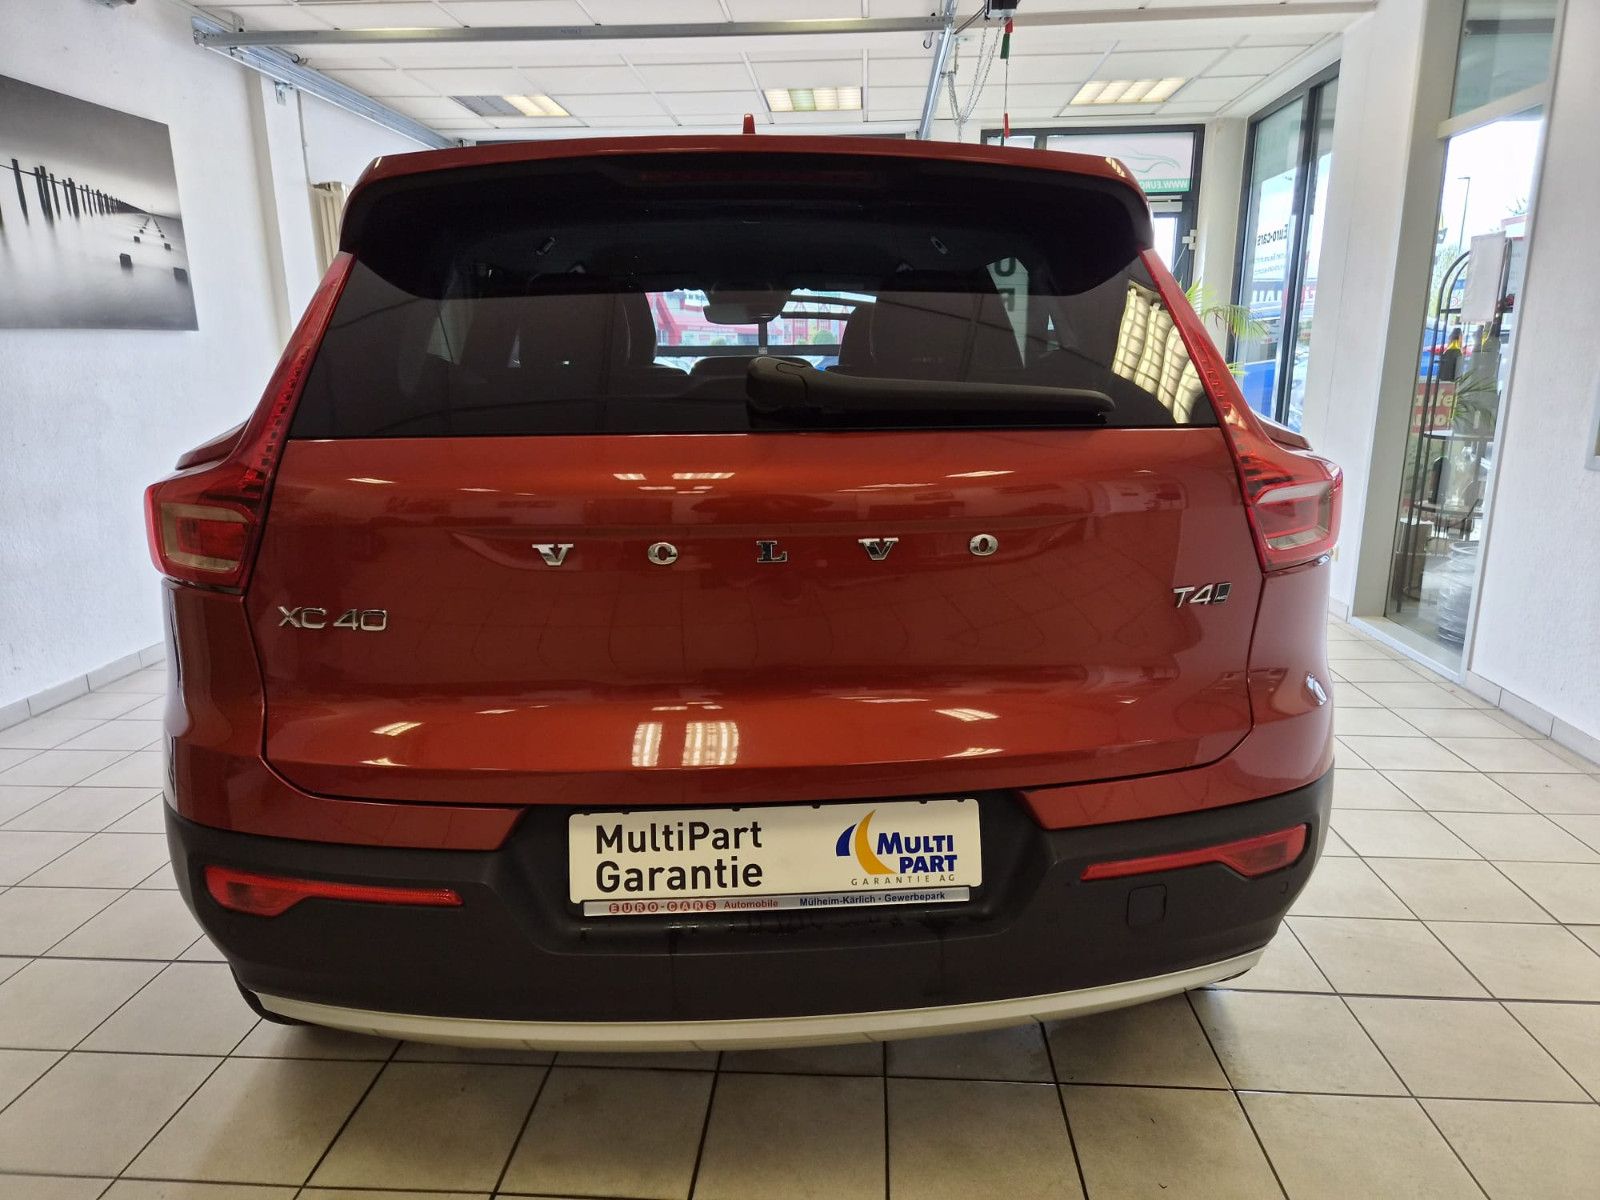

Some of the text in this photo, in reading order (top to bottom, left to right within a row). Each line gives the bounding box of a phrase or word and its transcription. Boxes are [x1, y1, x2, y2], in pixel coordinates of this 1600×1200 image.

[532, 534, 999, 566] VOLVO
[595, 821, 763, 854] MultiPart
[876, 832, 955, 855] MULTI
[595, 856, 764, 893] Garantie
[899, 855, 958, 875] PART
[850, 874, 956, 886] GARANTIE AG
[608, 898, 779, 914] EURO-CARS Automobile
[884, 891, 946, 903] Gewerbepark
